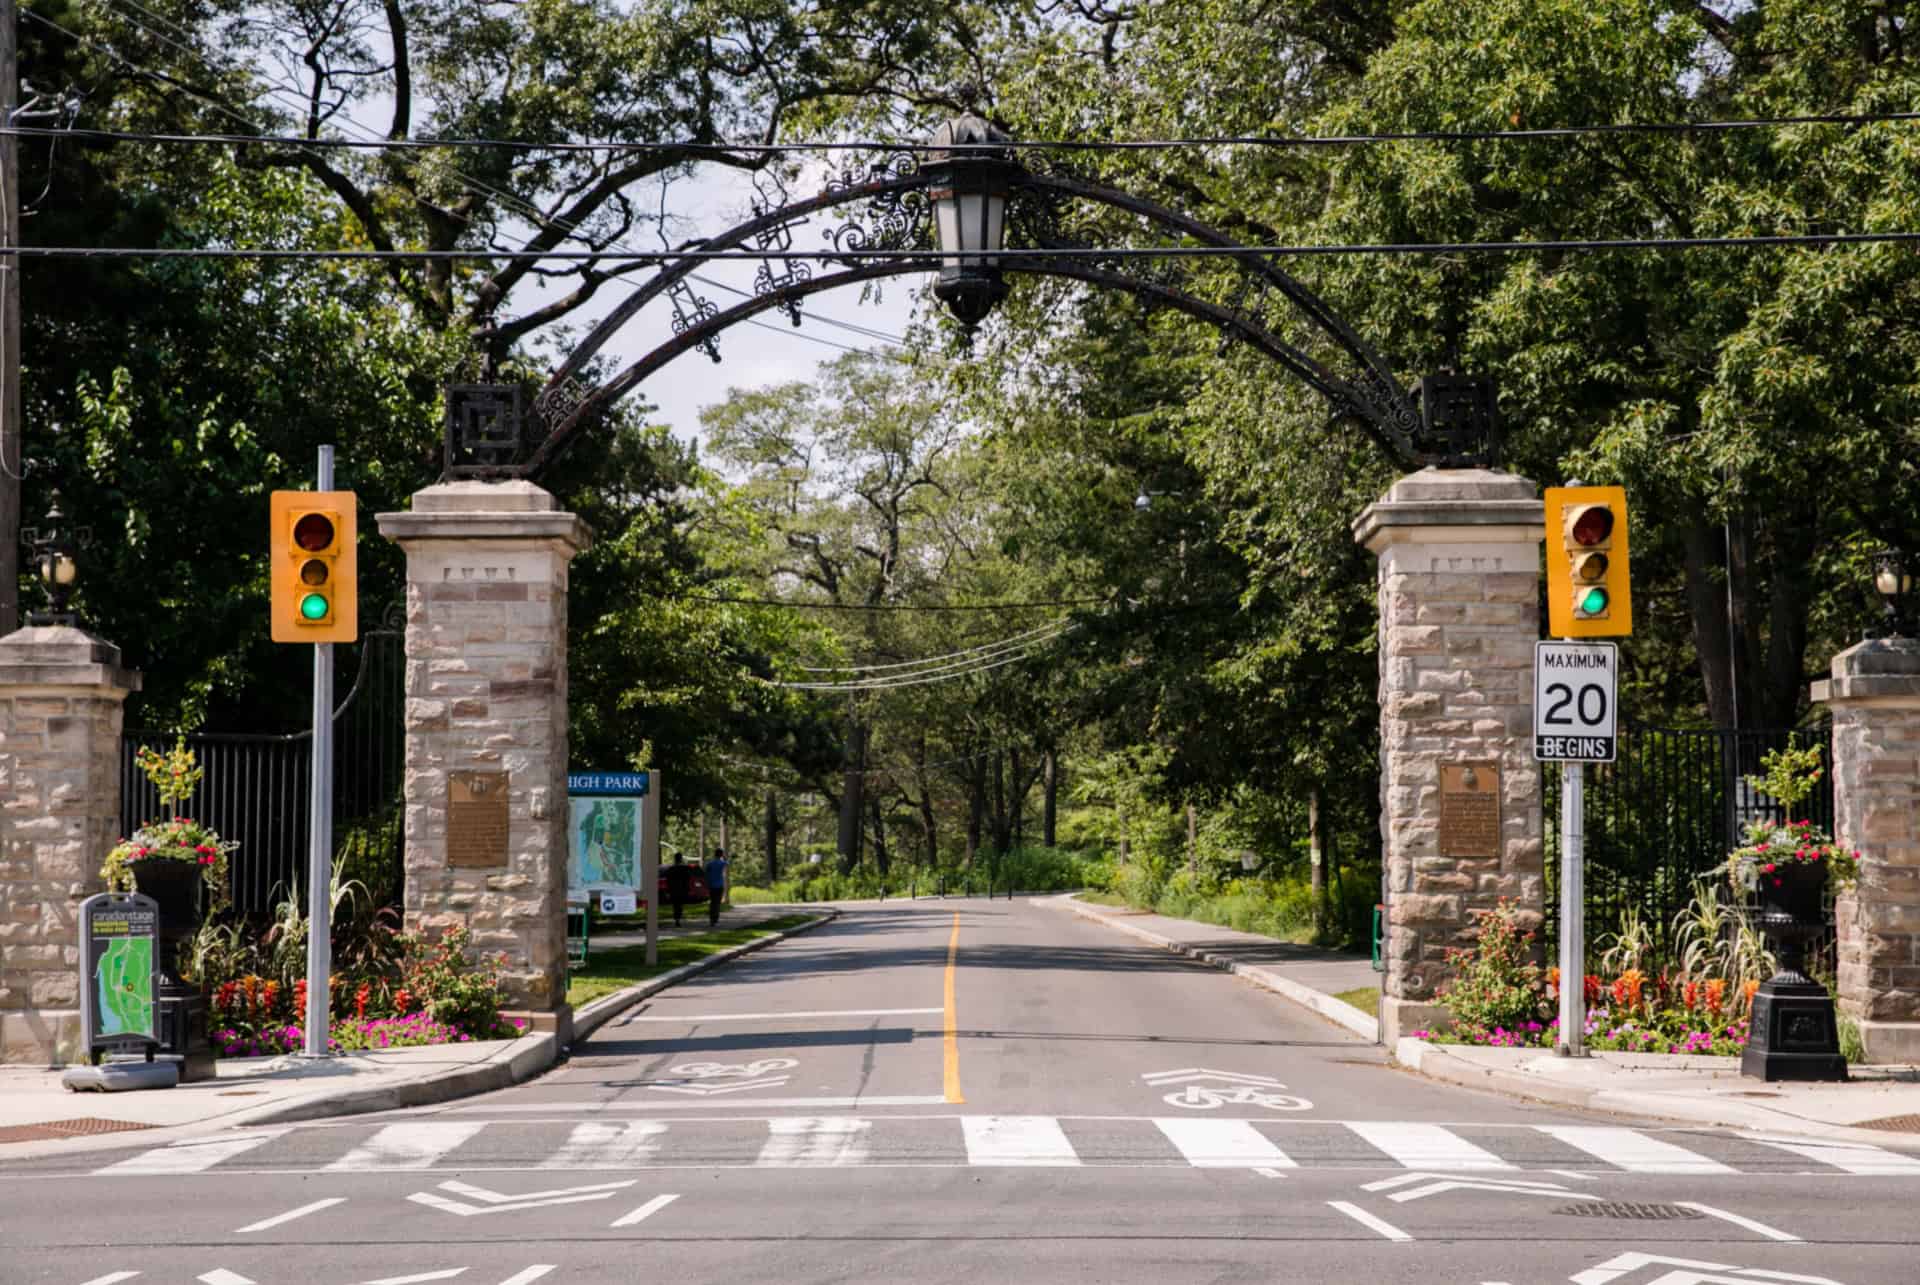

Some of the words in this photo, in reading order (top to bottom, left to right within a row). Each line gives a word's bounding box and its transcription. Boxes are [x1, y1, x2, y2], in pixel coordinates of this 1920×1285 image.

[1545, 654, 1607, 669] MAXIMUM
[1544, 682, 1607, 726] 20
[1543, 737, 1606, 757] BEGINS
[605, 775, 641, 789] PARK
